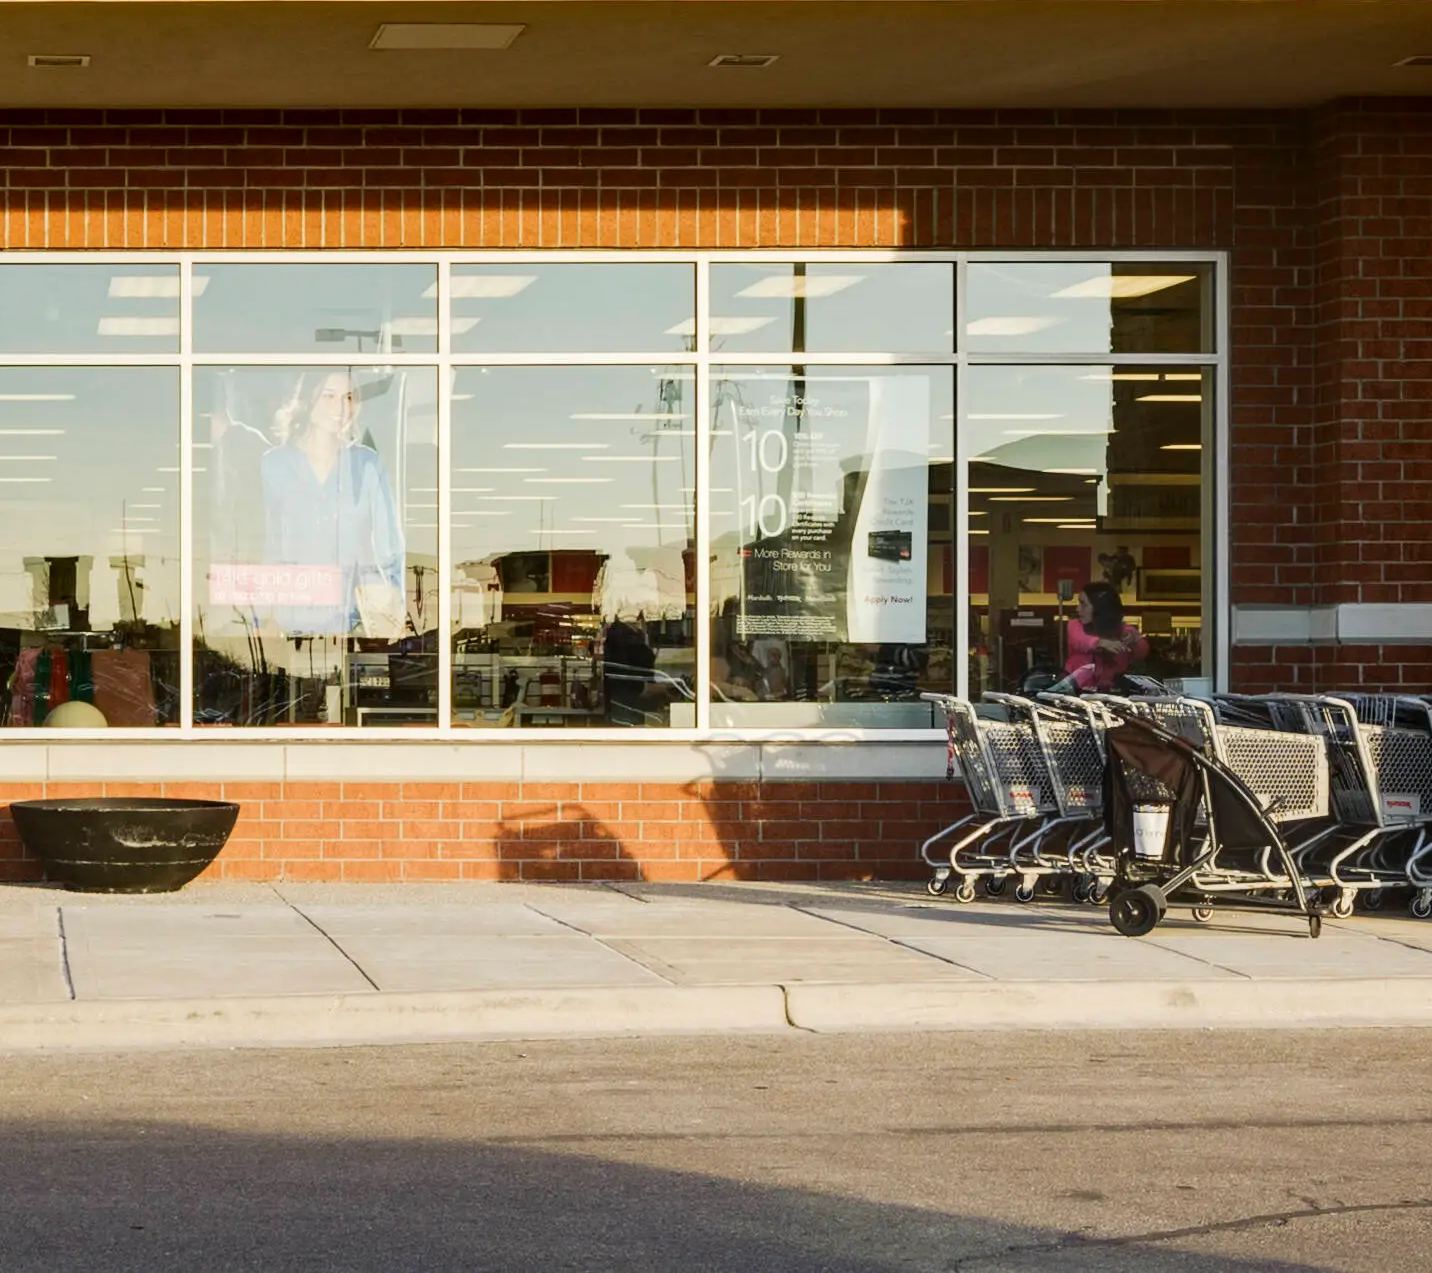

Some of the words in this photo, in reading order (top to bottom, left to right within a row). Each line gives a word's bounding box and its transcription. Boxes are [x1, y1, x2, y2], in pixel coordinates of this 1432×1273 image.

[787, 407, 805, 417] Day
[743, 430, 788, 472] 10
[741, 494, 787, 537] 10
[754, 548, 779, 559] More
[781, 548, 821, 559] Rewards
[823, 549, 832, 559] in
[773, 560, 798, 571] Store
[813, 561, 832, 572] You
[254, 569, 291, 589] gold
[865, 596, 888, 604] Apply
[890, 596, 913, 604] Now!
